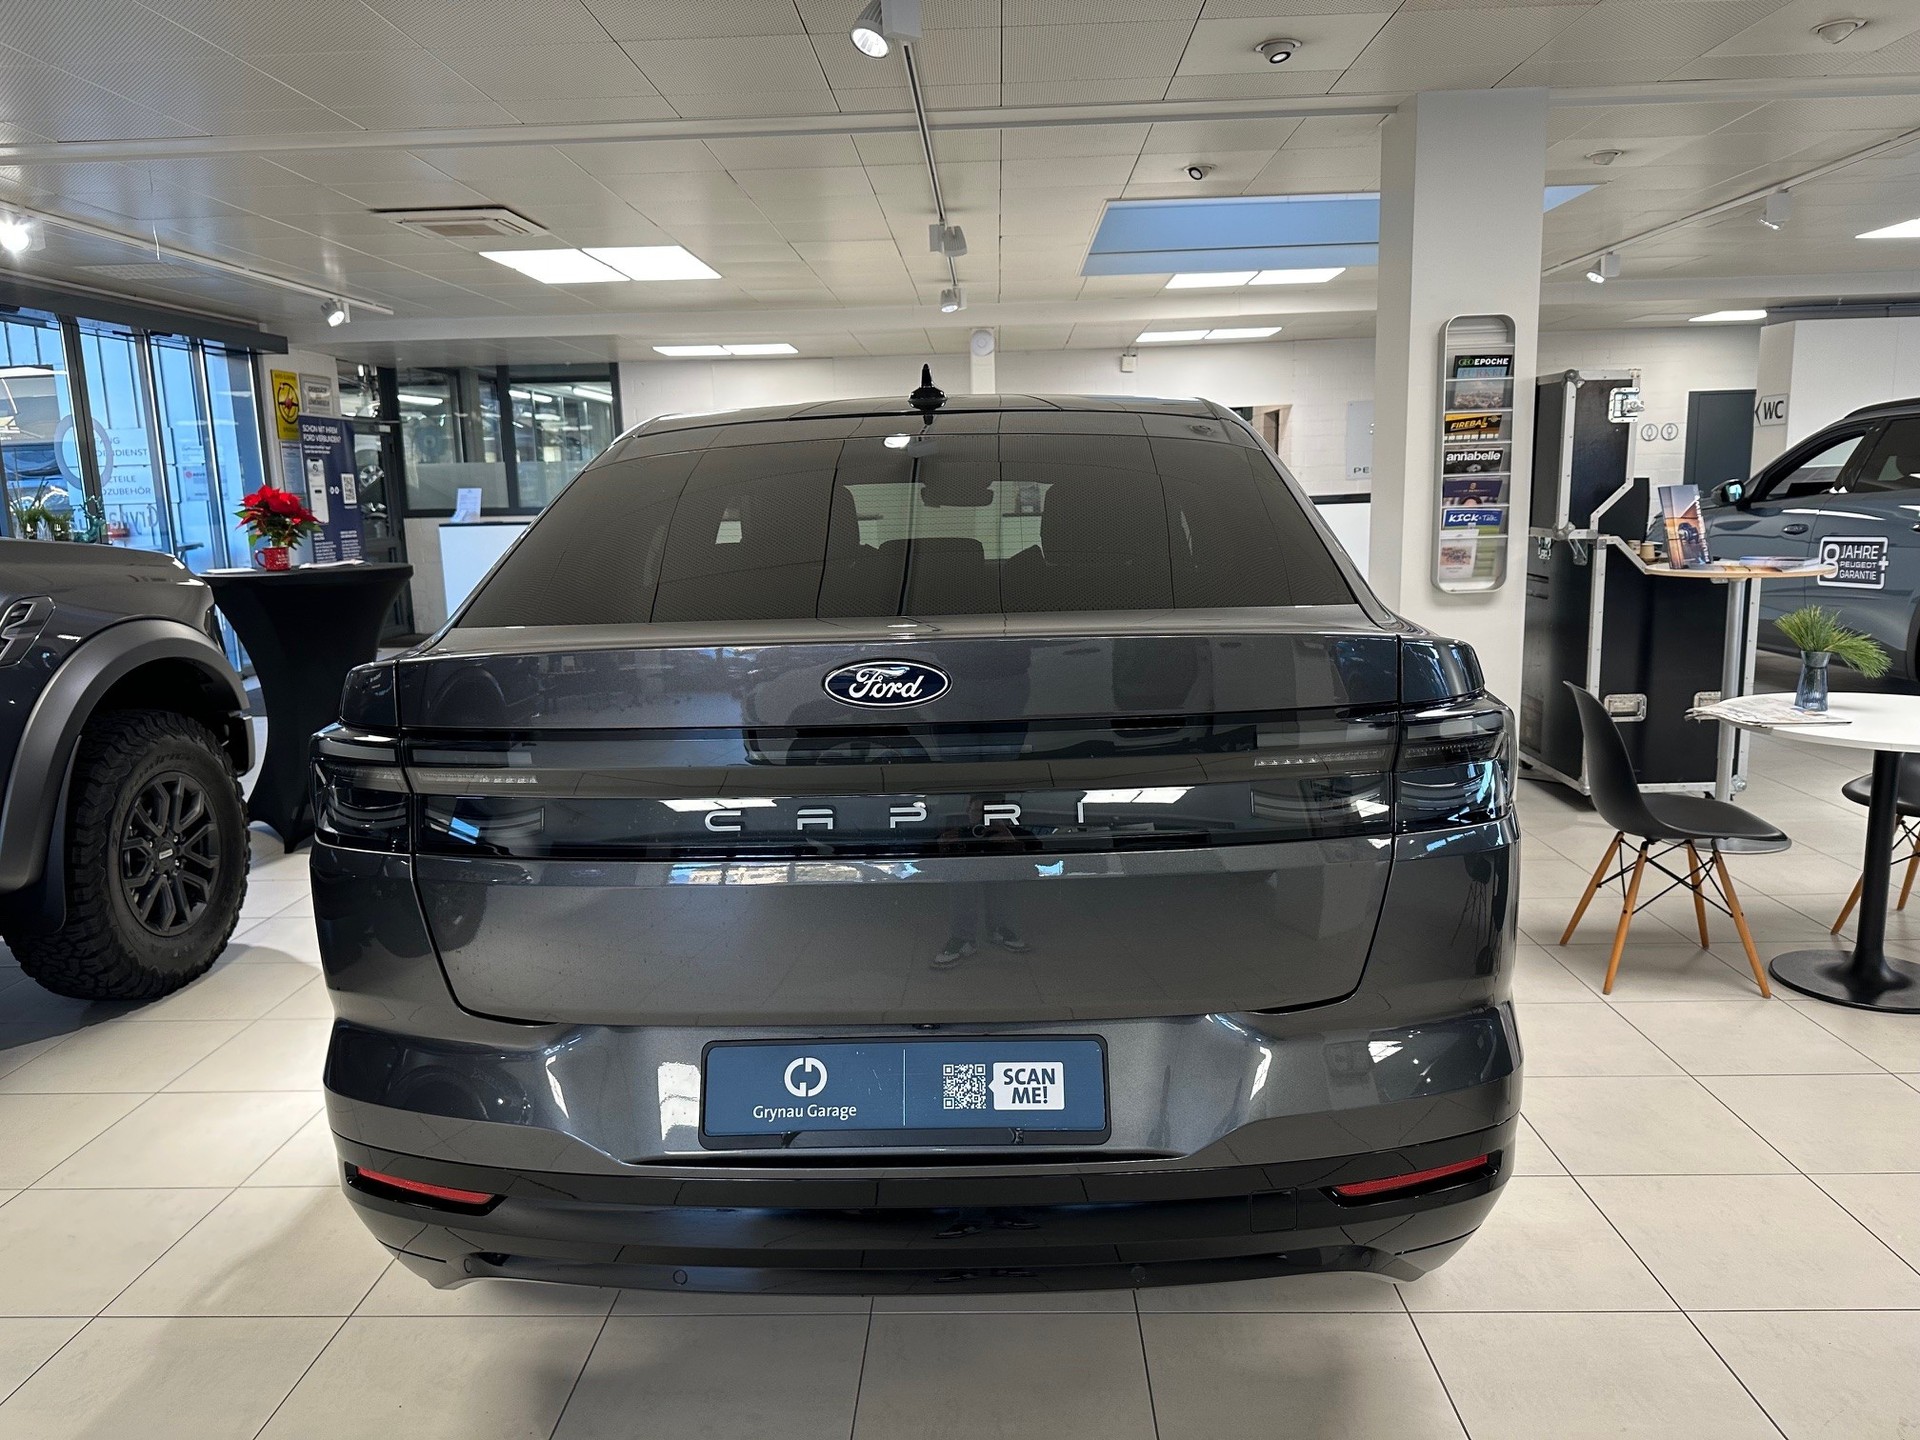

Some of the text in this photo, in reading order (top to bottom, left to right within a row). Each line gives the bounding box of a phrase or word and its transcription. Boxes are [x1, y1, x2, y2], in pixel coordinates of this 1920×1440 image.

[1474, 357, 1509, 366] EPOCHE
[1764, 400, 1784, 420] WC
[1446, 451, 1501, 462] annabelle
[1353, 466, 1371, 475] PE
[1448, 513, 1479, 522] KICK
[1823, 543, 1880, 579] 8 JAHRE
[1840, 560, 1877, 568] PEUGEOT
[1839, 569, 1877, 580] GARANTIE
[848, 666, 925, 699] Ford
[704, 802, 1085, 832] CAPRI
[1002, 1067, 1056, 1086] SCAN
[1010, 1086, 1049, 1105] ME!
[752, 1103, 857, 1121] Grynau Garage
